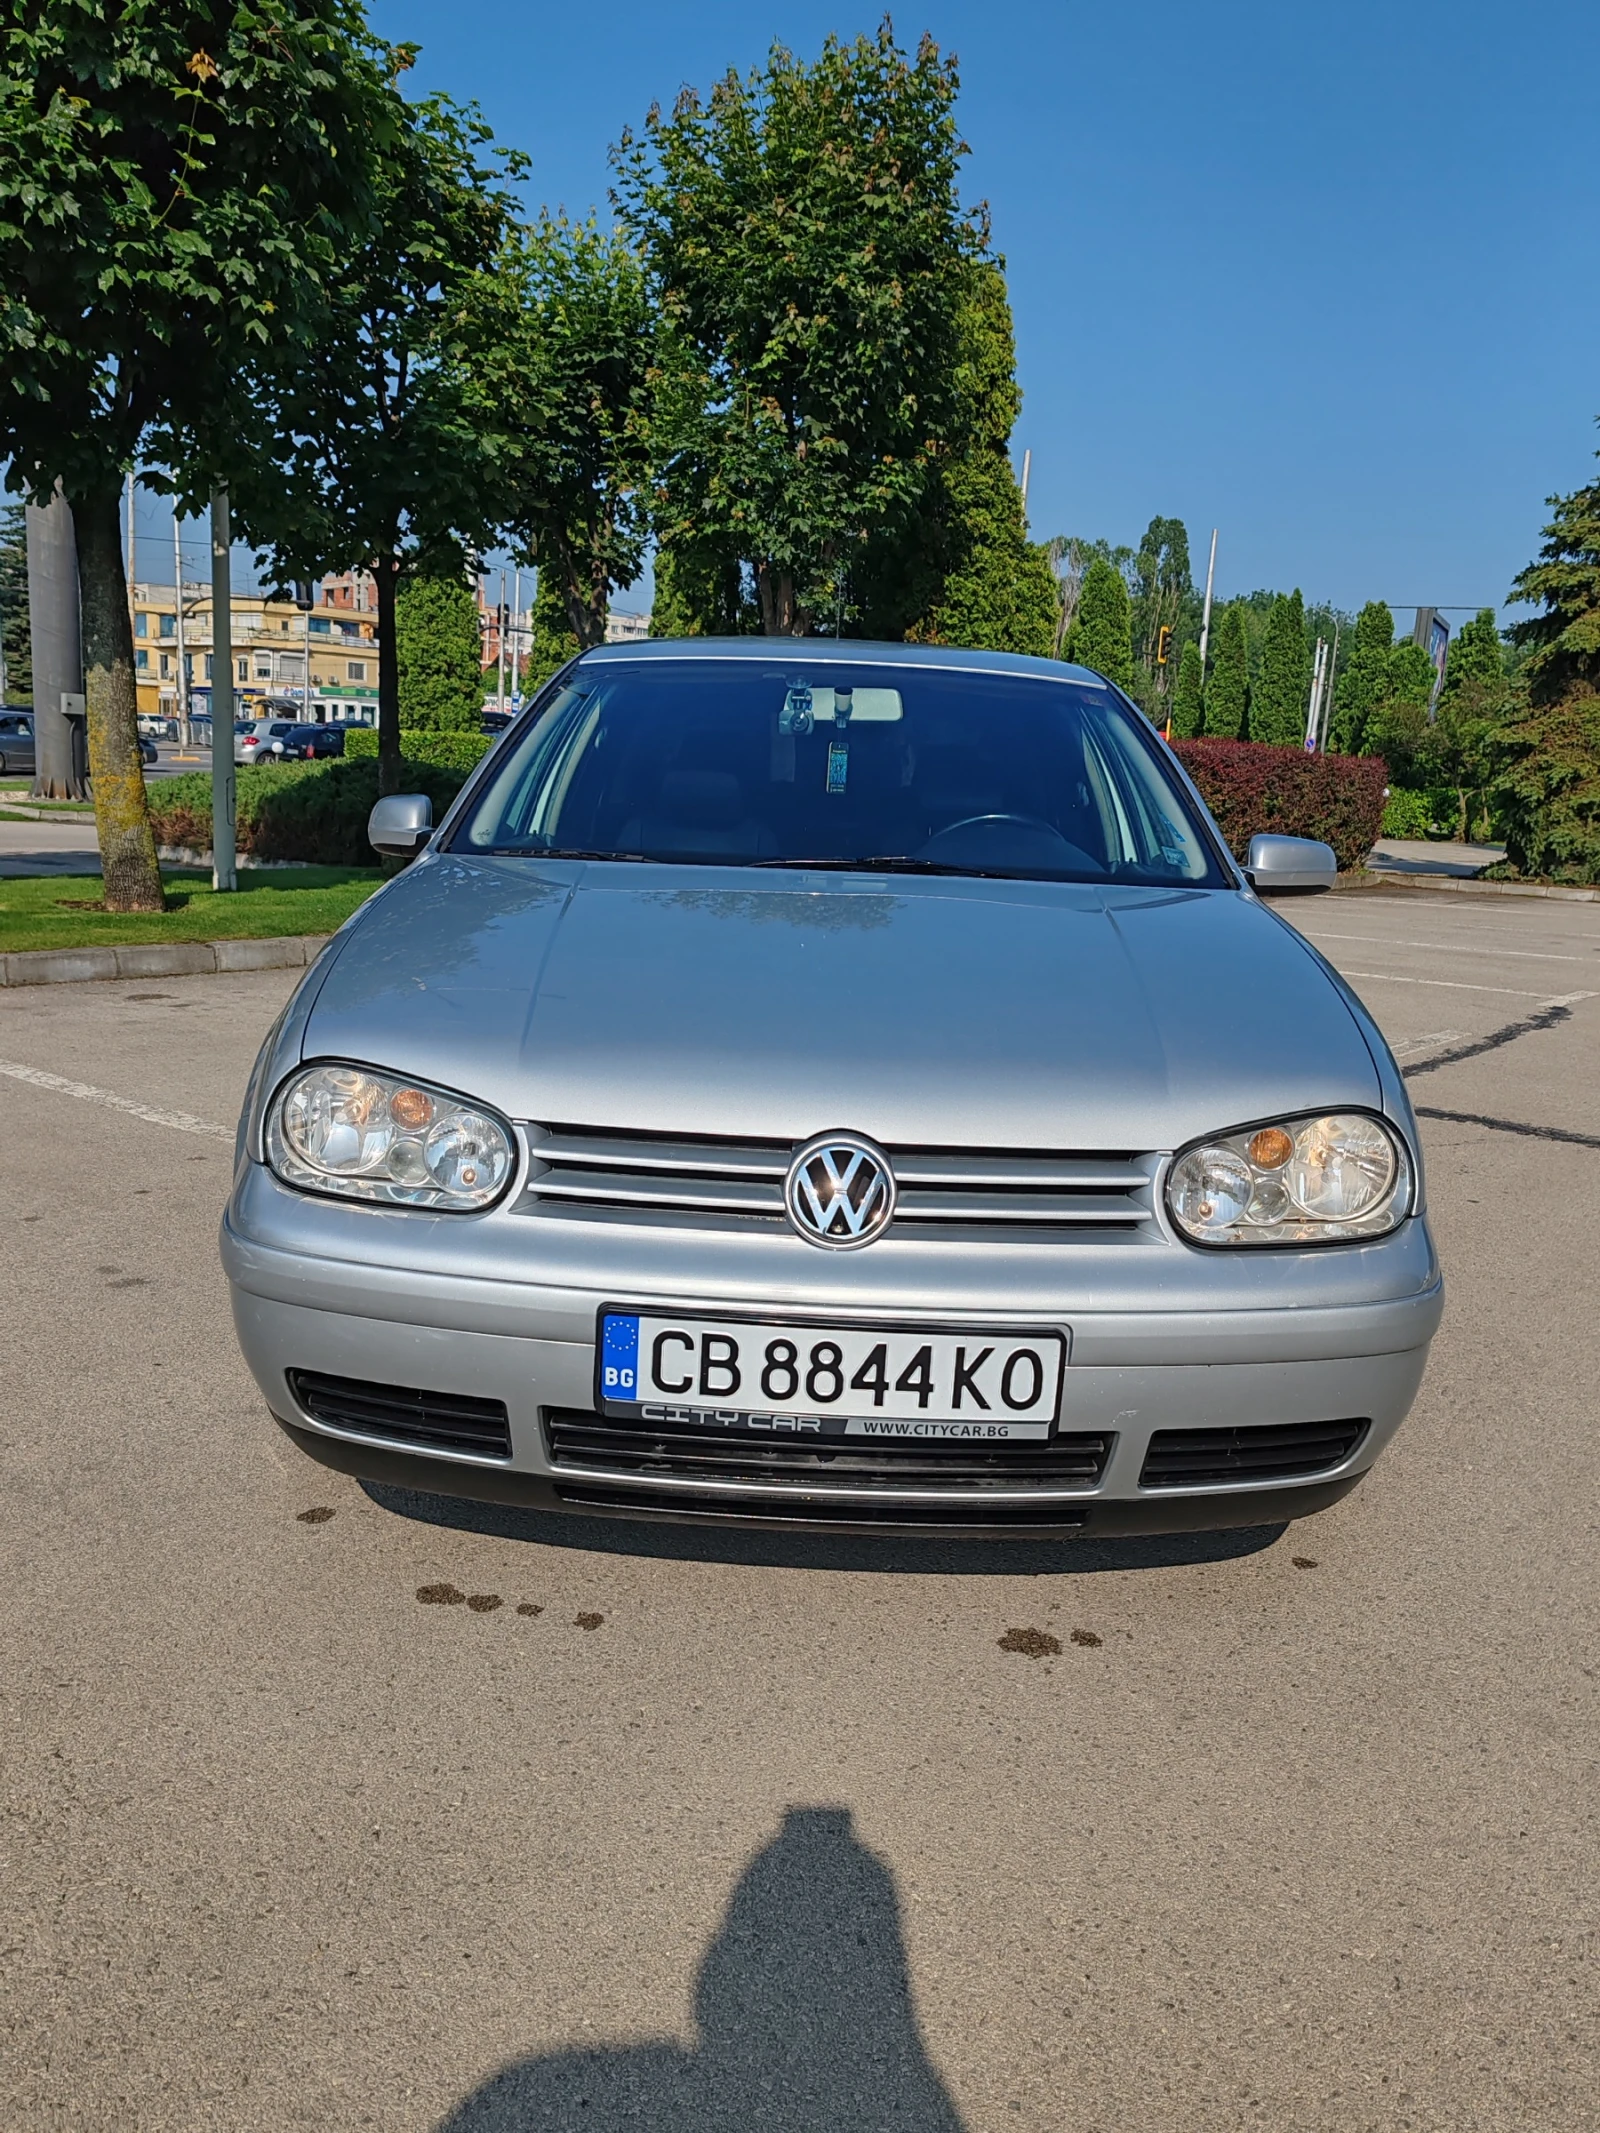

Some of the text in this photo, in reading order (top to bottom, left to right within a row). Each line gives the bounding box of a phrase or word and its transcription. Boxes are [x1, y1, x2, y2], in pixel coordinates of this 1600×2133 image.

[604, 1366, 634, 1388] BG
[651, 1330, 1044, 1411] CB 8844 KO
[641, 1404, 821, 1433] CITY CAR
[863, 1421, 1009, 1437] WWW.CITYCAR.BG
